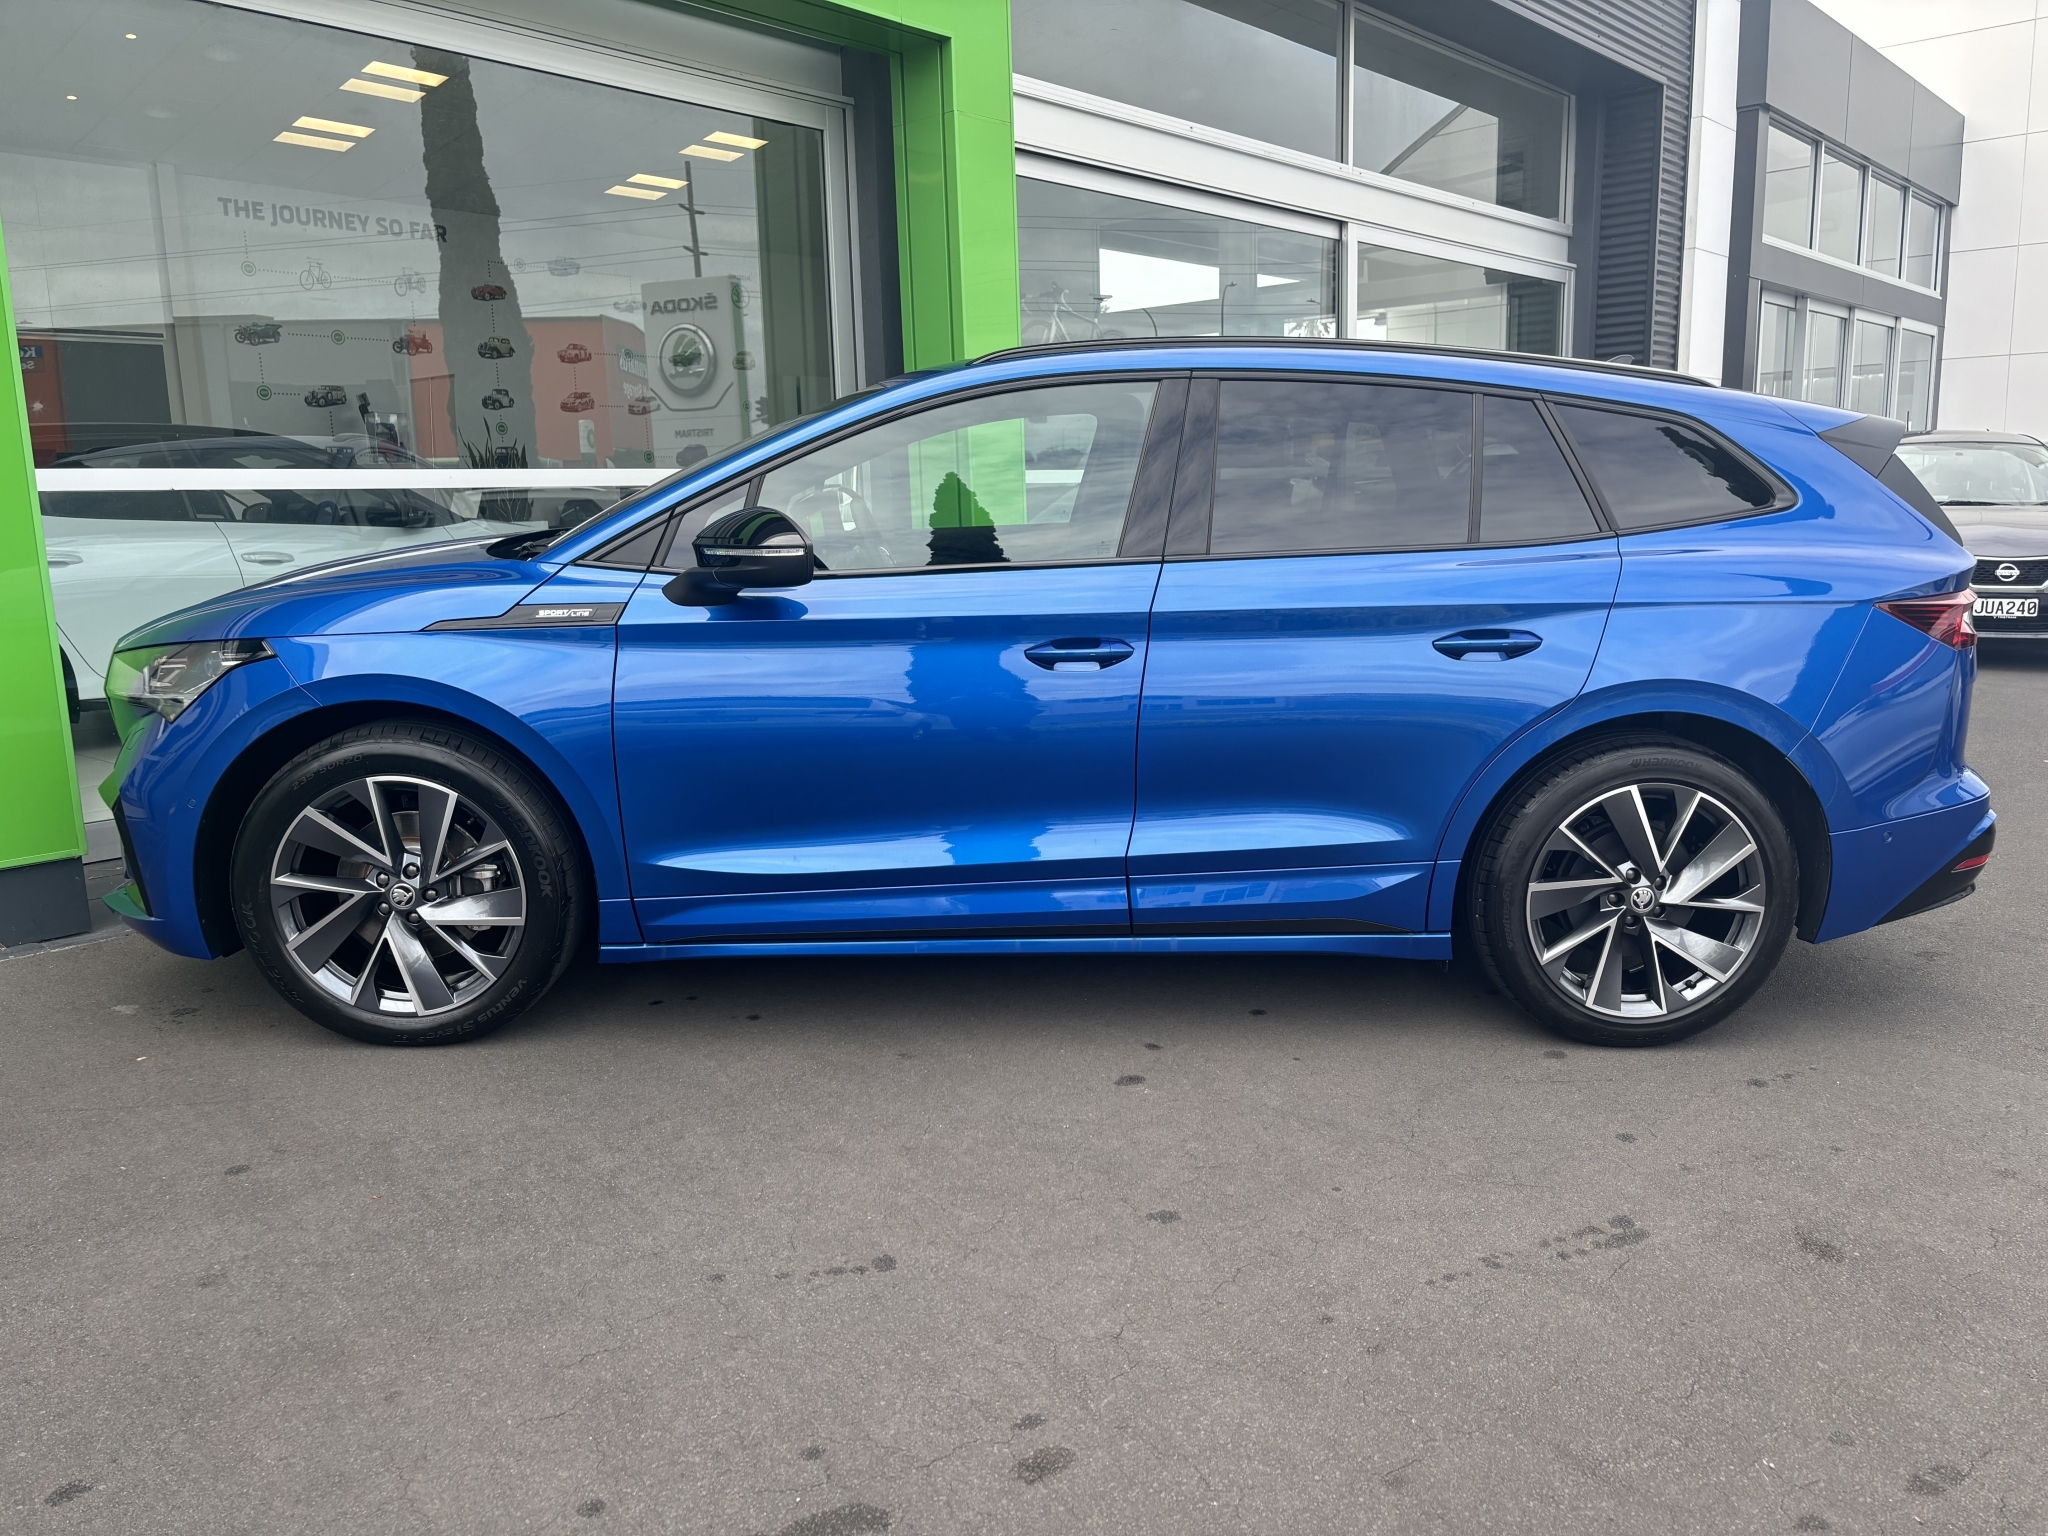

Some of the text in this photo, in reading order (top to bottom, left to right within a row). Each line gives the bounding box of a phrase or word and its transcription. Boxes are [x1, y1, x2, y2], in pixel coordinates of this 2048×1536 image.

[217, 197, 448, 243] THE JOURNEY SO FAR
[1974, 600, 2037, 615] JUA240
